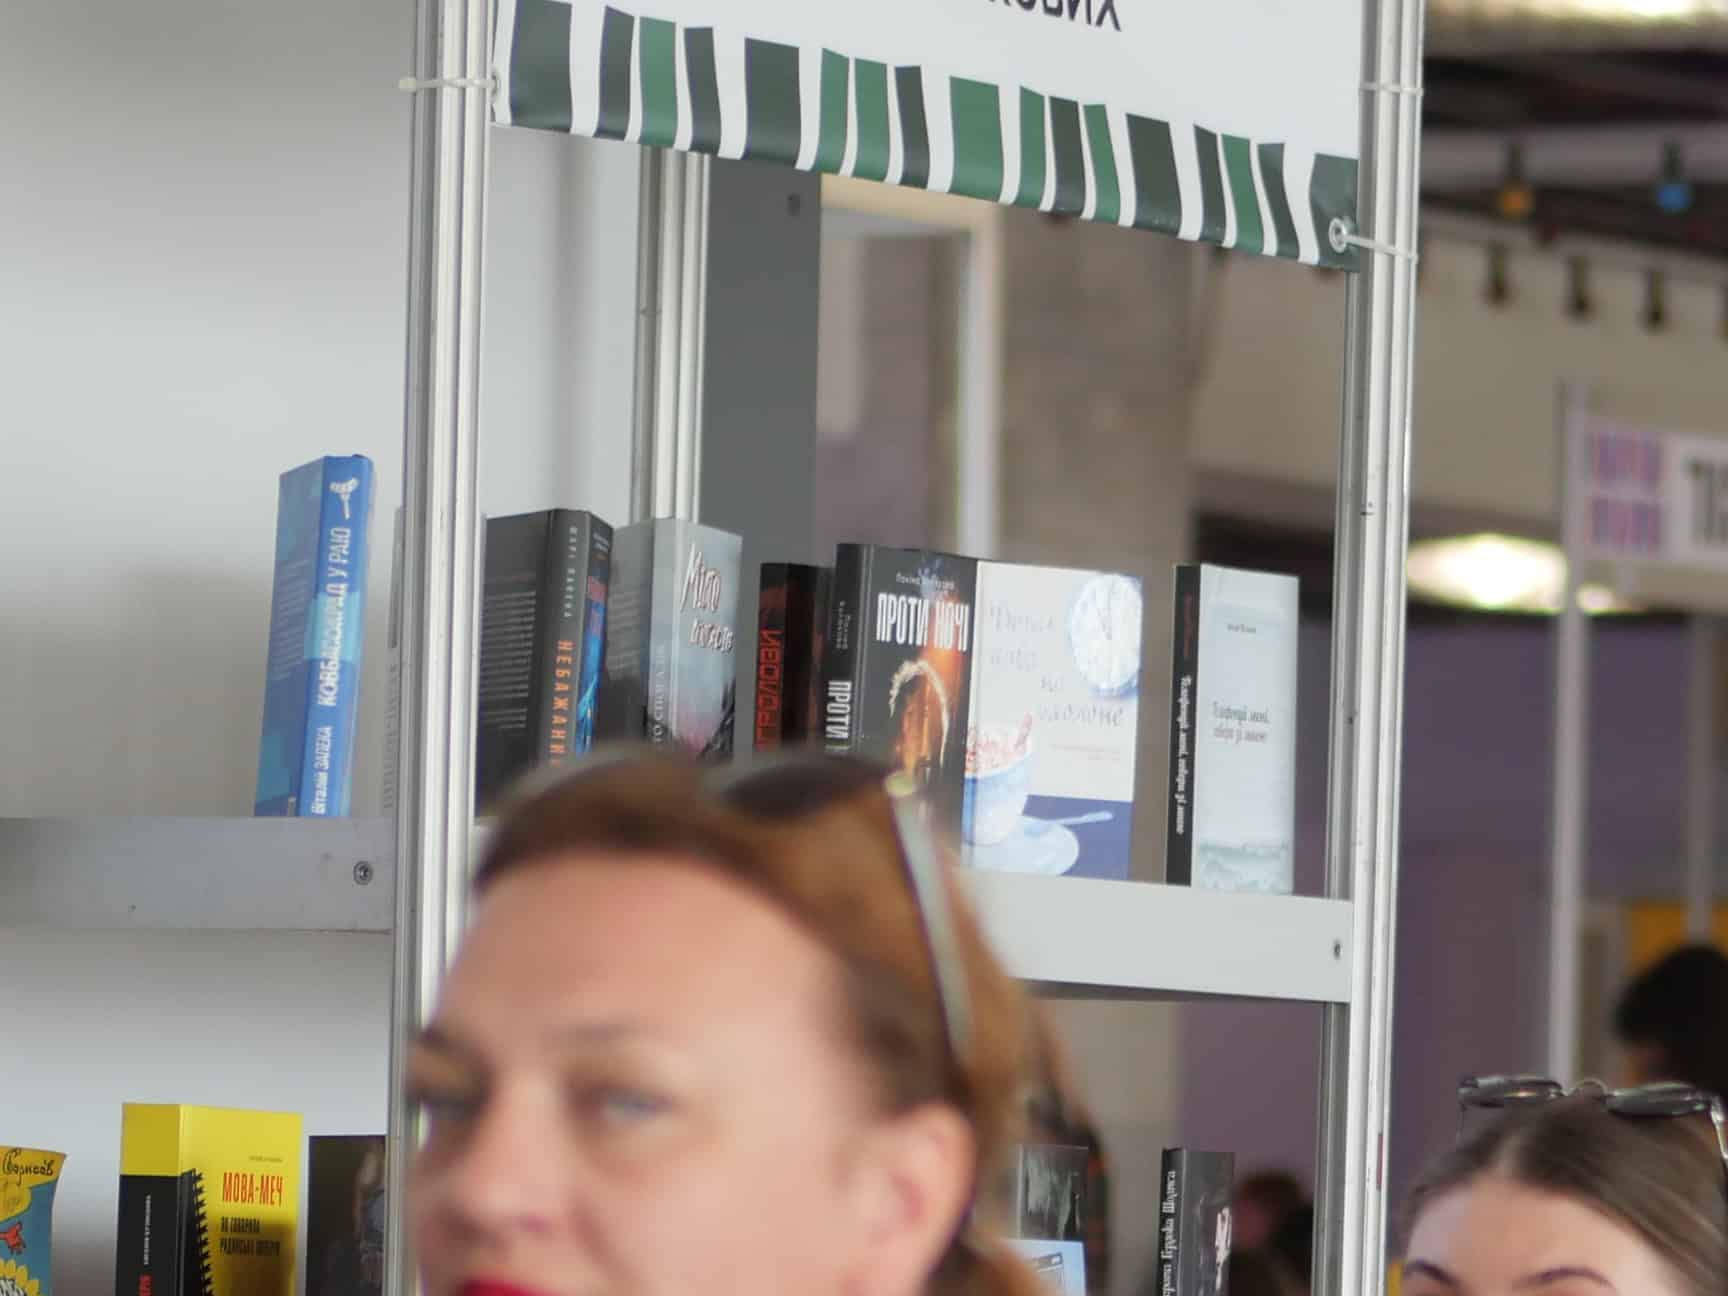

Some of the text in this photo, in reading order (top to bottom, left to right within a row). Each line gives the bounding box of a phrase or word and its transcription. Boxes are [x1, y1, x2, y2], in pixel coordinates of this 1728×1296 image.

[329, 526, 351, 566] РАЮ
[876, 593, 929, 647] ПРОТИ
[934, 602, 969, 652] НОЧІ
[825, 680, 852, 740] ПРОТИ
[223, 1172, 283, 1207] МОВА-МЕЧ
